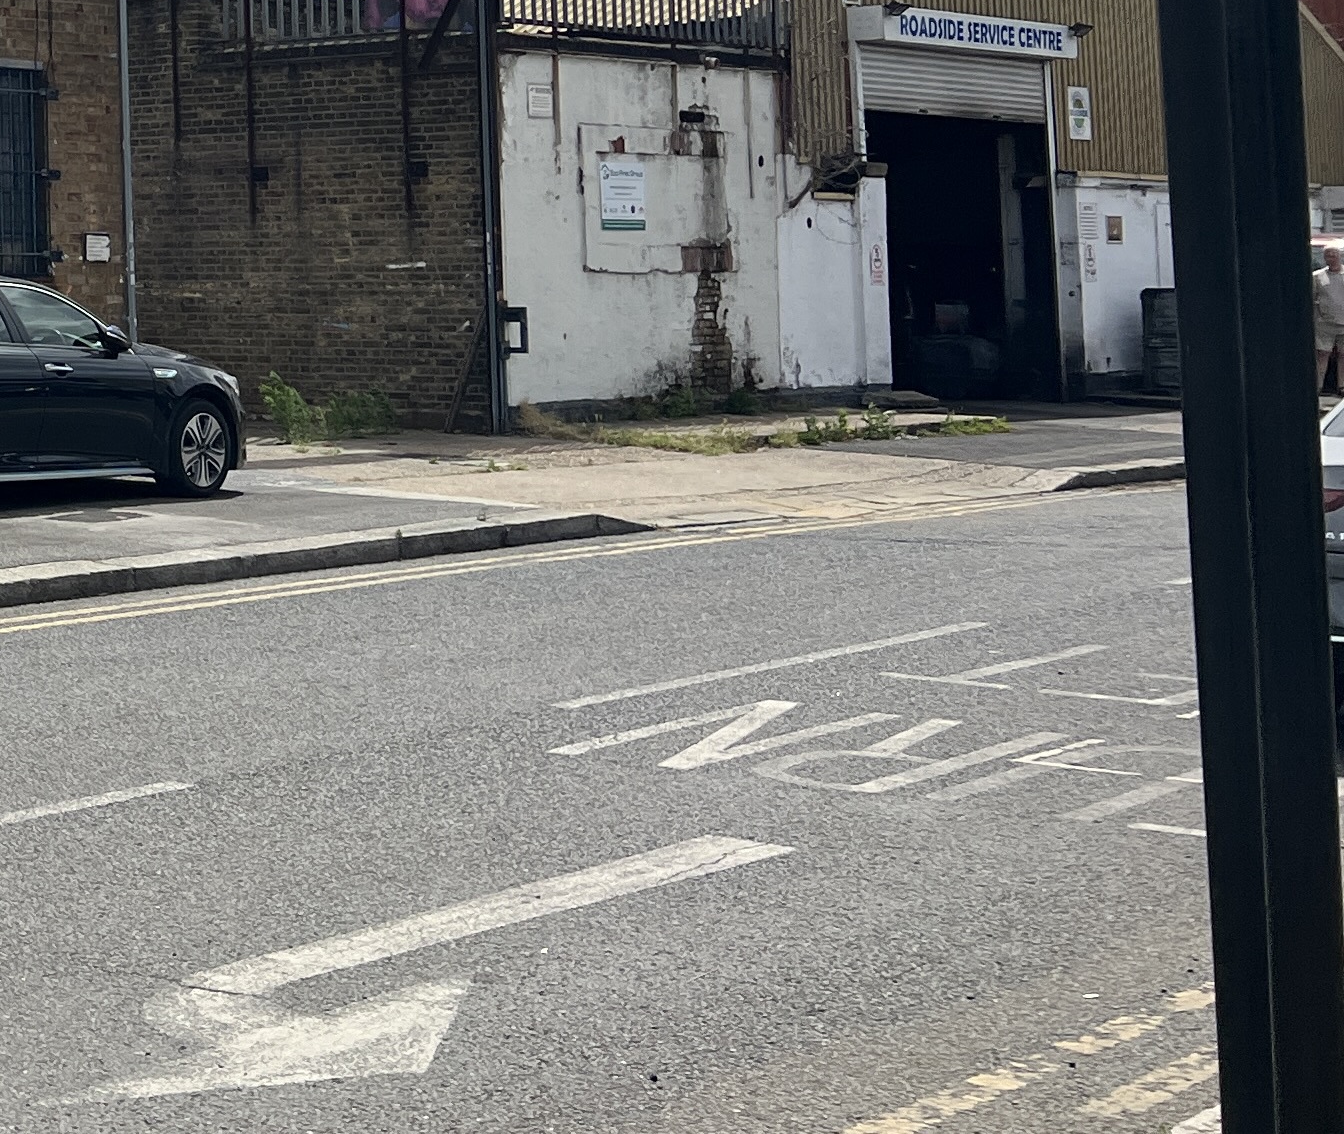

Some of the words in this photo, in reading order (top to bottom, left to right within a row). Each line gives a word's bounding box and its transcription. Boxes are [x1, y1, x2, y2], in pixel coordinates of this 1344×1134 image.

[900, 14, 965, 41] ROADSIDE
[968, 21, 1016, 47] SERVICE
[1018, 27, 1063, 51] CENTRE
